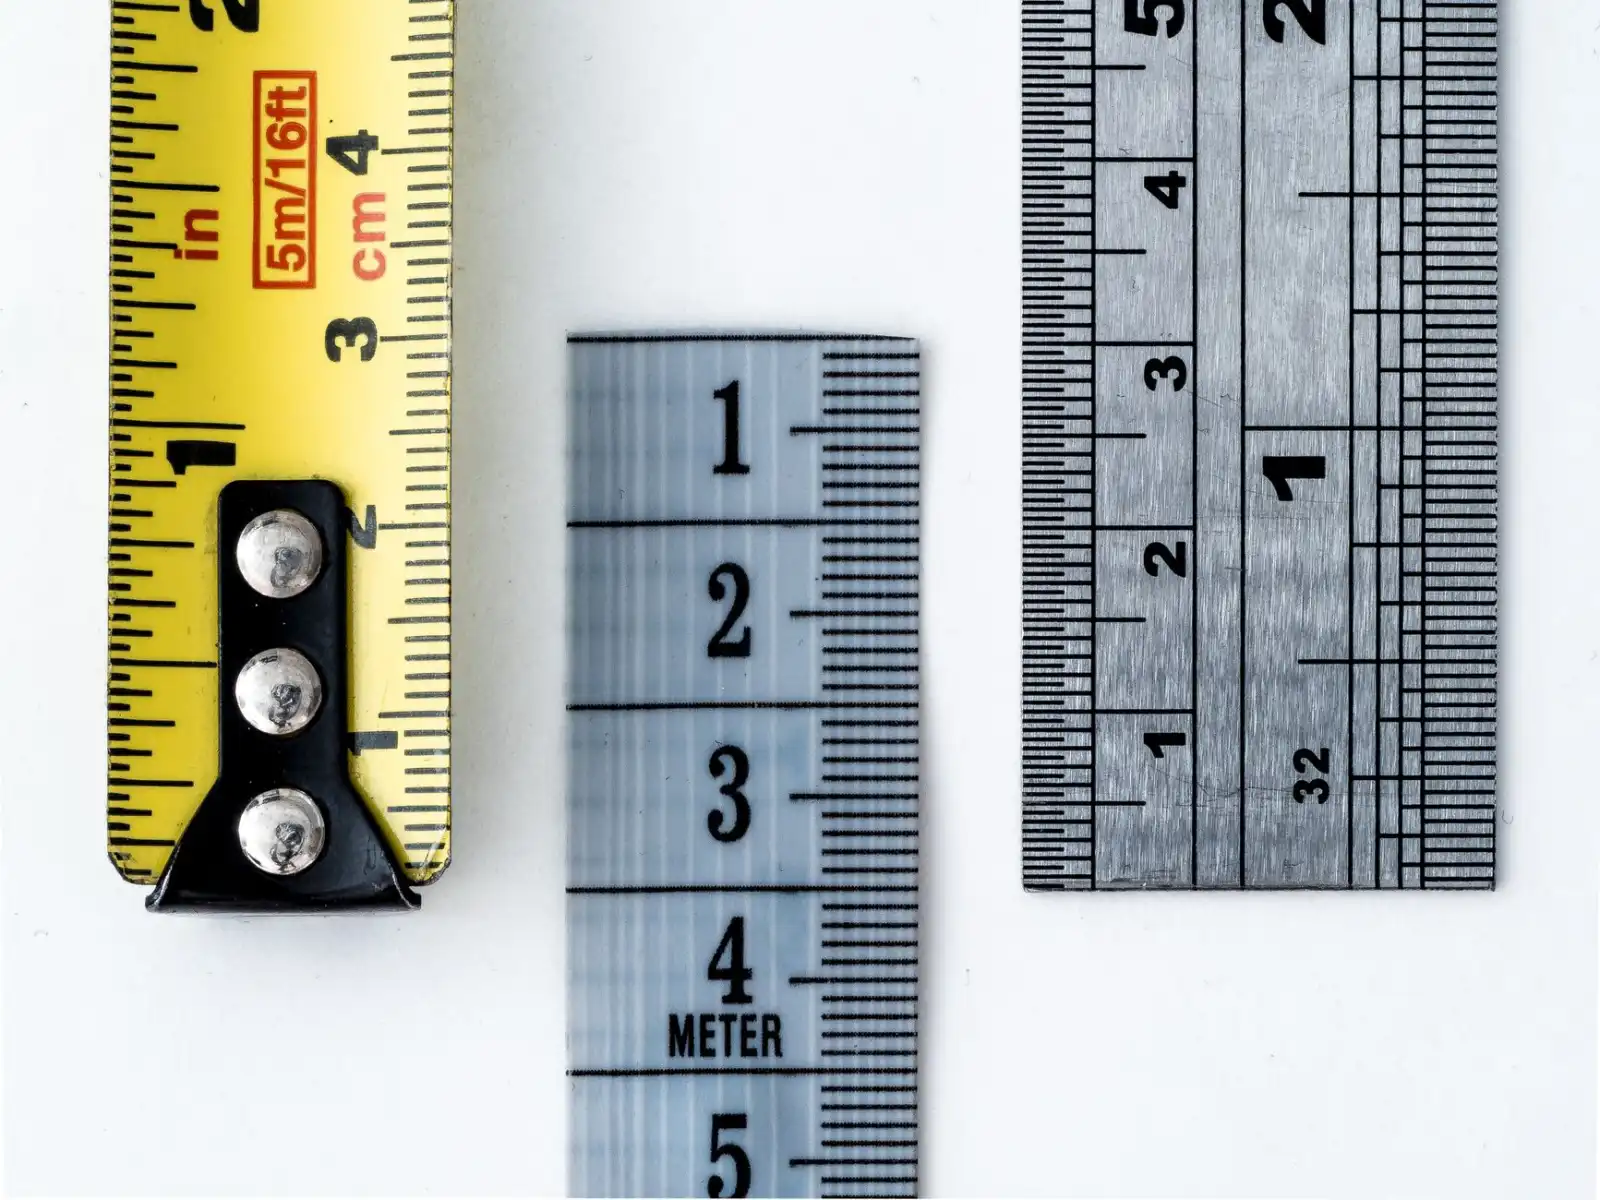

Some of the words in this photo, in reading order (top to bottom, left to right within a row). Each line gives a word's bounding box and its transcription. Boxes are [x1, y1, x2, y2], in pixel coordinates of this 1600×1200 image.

[1124, 0, 1185, 39] 5
[1262, 0, 1326, 45] 2
[326, 129, 379, 175] 4
[265, 85, 307, 272] 5m/16ft
[1143, 170, 1187, 210] 4
[173, 208, 219, 261] in
[352, 192, 387, 281] cm
[324, 316, 378, 362] 3
[1143, 355, 1187, 392] 3
[713, 380, 750, 475] 1
[166, 440, 236, 475] 1
[1262, 456, 1326, 502] 1
[1143, 541, 1186, 578] 2
[707, 562, 752, 658] 2
[347, 731, 398, 756] 1
[1143, 732, 1186, 759] 1
[707, 744, 752, 843] 3
[1292, 747, 1330, 805] 32
[708, 916, 753, 1004] 4
[668, 1013, 784, 1058] METER
[707, 1112, 752, 1198] 5
